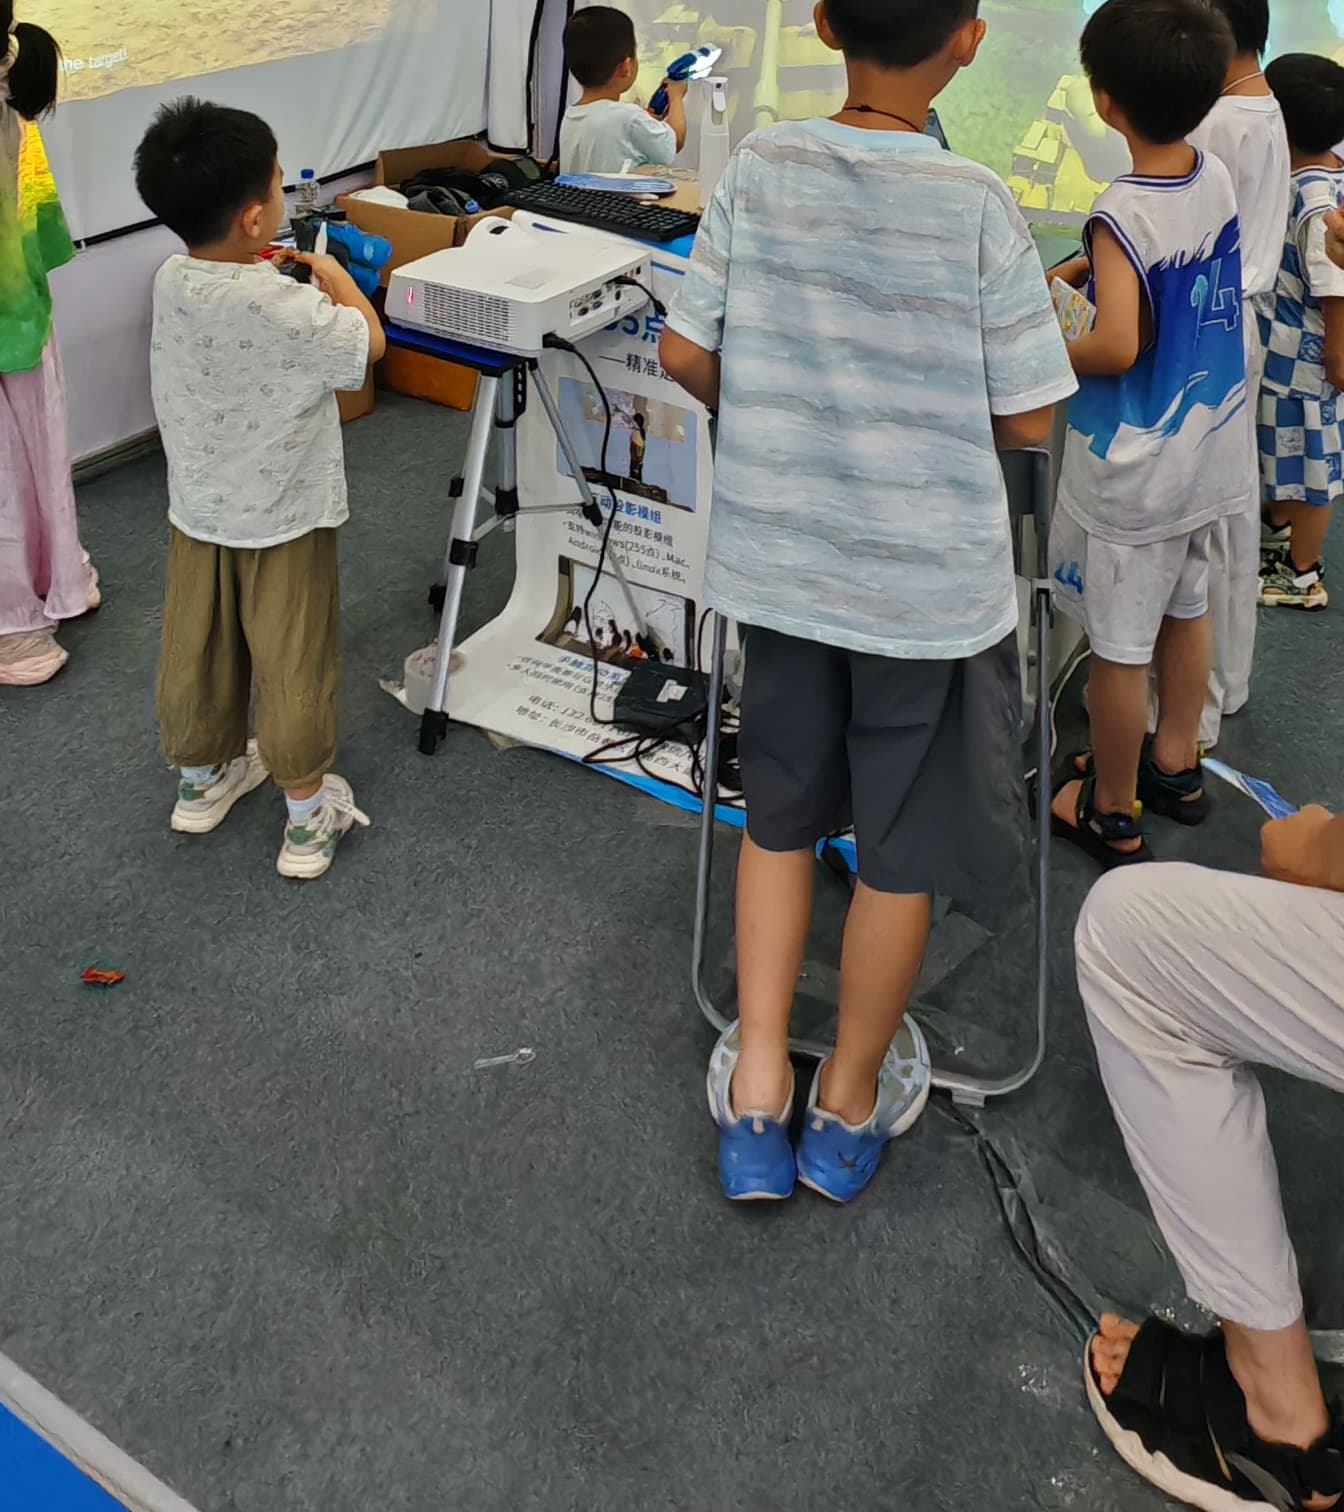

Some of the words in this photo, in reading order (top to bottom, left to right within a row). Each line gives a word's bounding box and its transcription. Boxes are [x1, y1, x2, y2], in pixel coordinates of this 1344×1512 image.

[592, 491, 662, 525] 动投影模组
